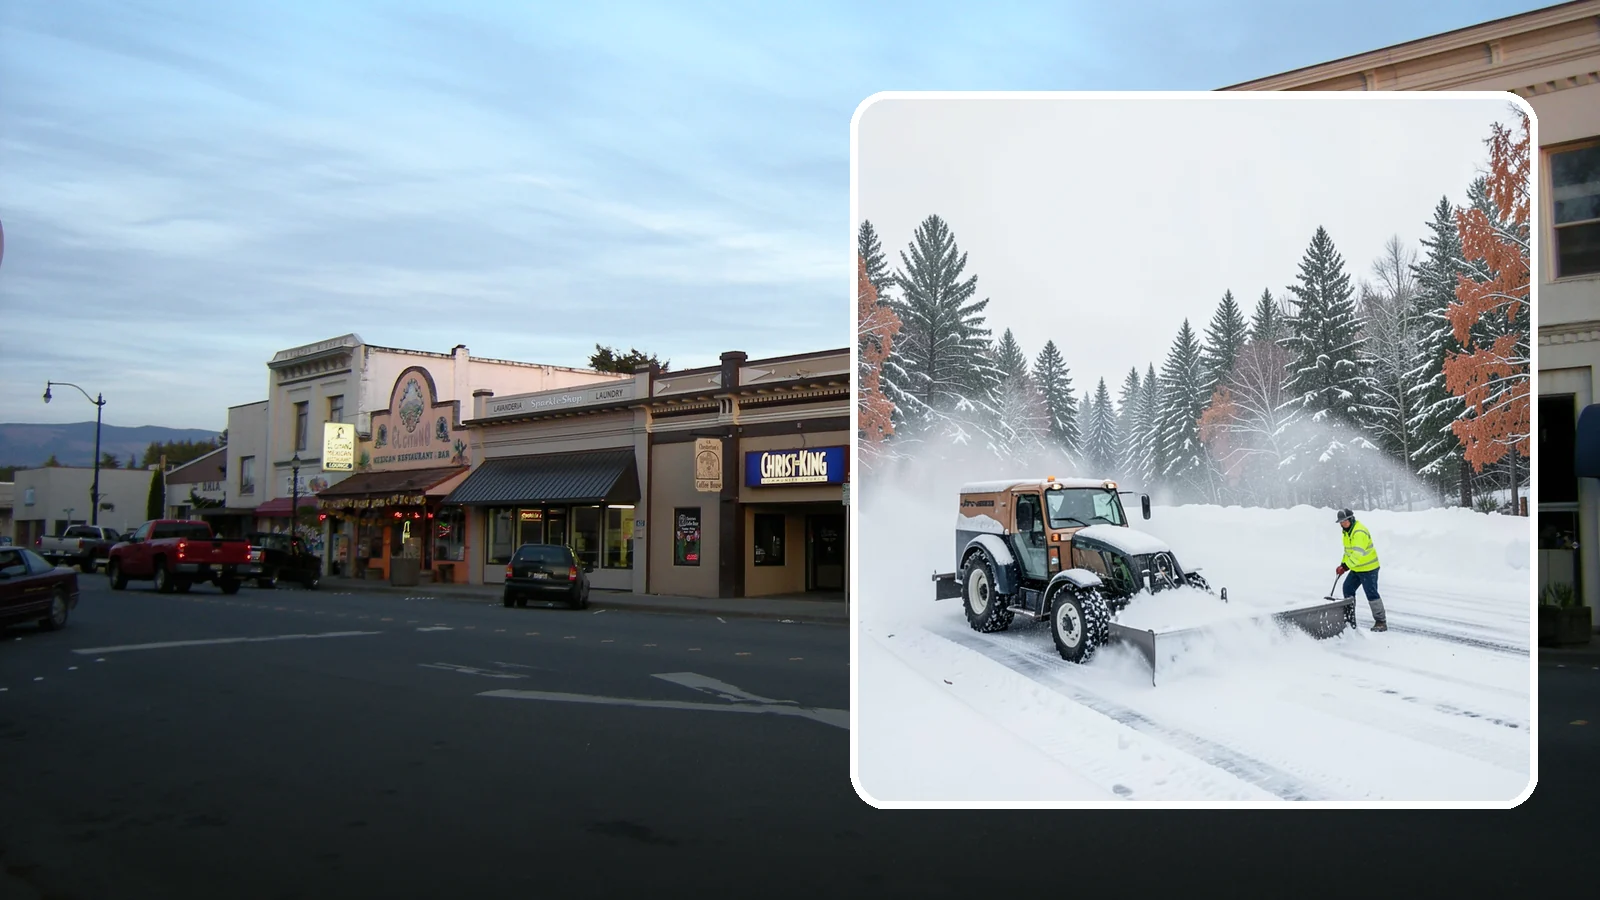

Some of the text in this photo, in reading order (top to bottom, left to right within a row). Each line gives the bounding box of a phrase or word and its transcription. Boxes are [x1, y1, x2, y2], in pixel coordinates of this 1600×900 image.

[595, 389, 623, 400] LAUNDRY
[493, 402, 522, 412] LAVANDERIA
[531, 395, 582, 409] Sparkle Shop
[373, 455, 397, 464] MEXICAN
[397, 452, 434, 462] RESTAURANT
[438, 450, 450, 459] BAR
[761, 450, 827, 478] CHRIST KING
[697, 481, 721, 489] Coffee House
